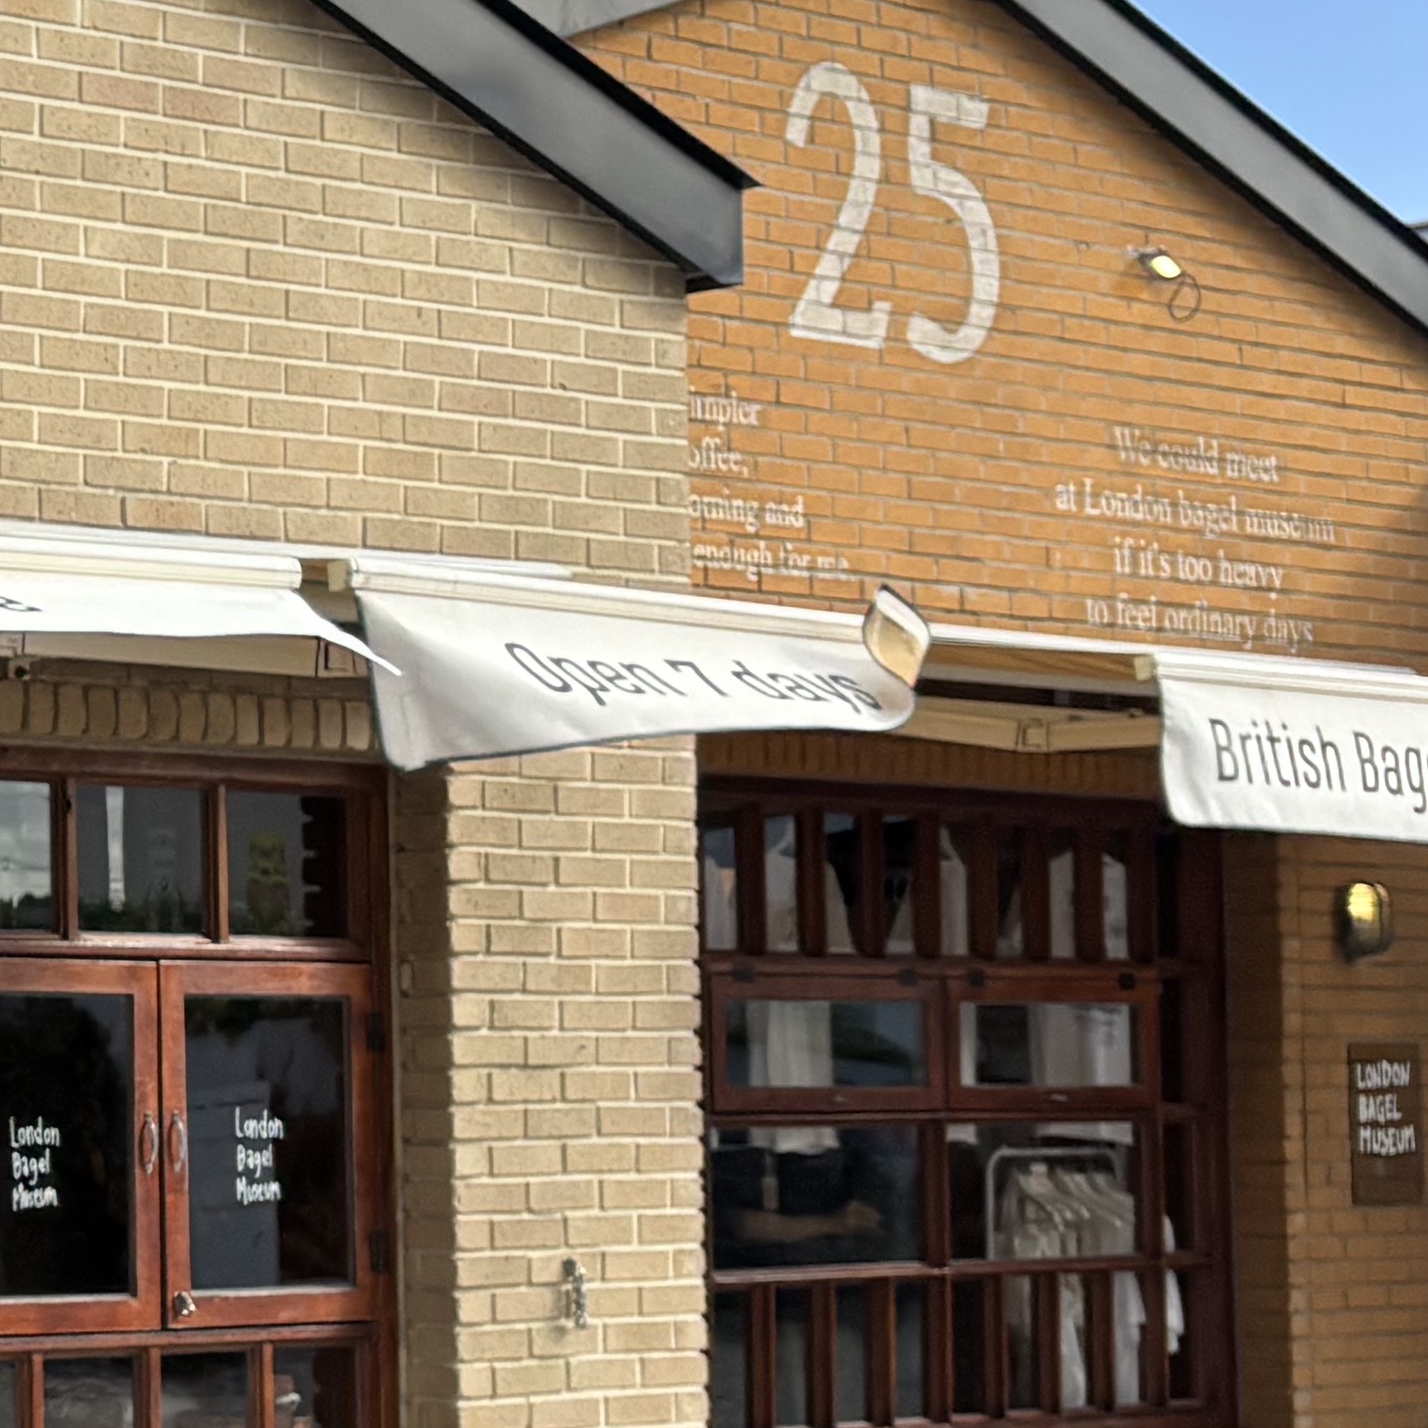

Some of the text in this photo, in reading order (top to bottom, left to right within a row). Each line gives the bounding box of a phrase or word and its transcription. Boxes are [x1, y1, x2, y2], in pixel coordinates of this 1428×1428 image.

[785, 61, 999, 363] 25
[1113, 426, 1279, 483] We could meet
[765, 495, 804, 528] and
[1055, 482, 1077, 512] at
[1083, 477, 1172, 523] London
[1178, 490, 1237, 538] bagel
[1113, 536, 1284, 600] if it's too heavy
[1085, 592, 1313, 653] to feel ordinary days
[504, 642, 882, 713] Open 7 days
[1209, 718, 1428, 814] British Bag
[1357, 1059, 1410, 1090] LONDON
[235, 1106, 284, 1140] London
[1359, 1093, 1402, 1124] BAGEL
[9, 1115, 60, 1148] London
[1359, 1123, 1416, 1156] MUSEUM
[12, 1147, 51, 1185] Bagel
[236, 1144, 273, 1178] Bagel
[12, 1182, 59, 1212] Museum
[236, 1176, 282, 1205] Museum
